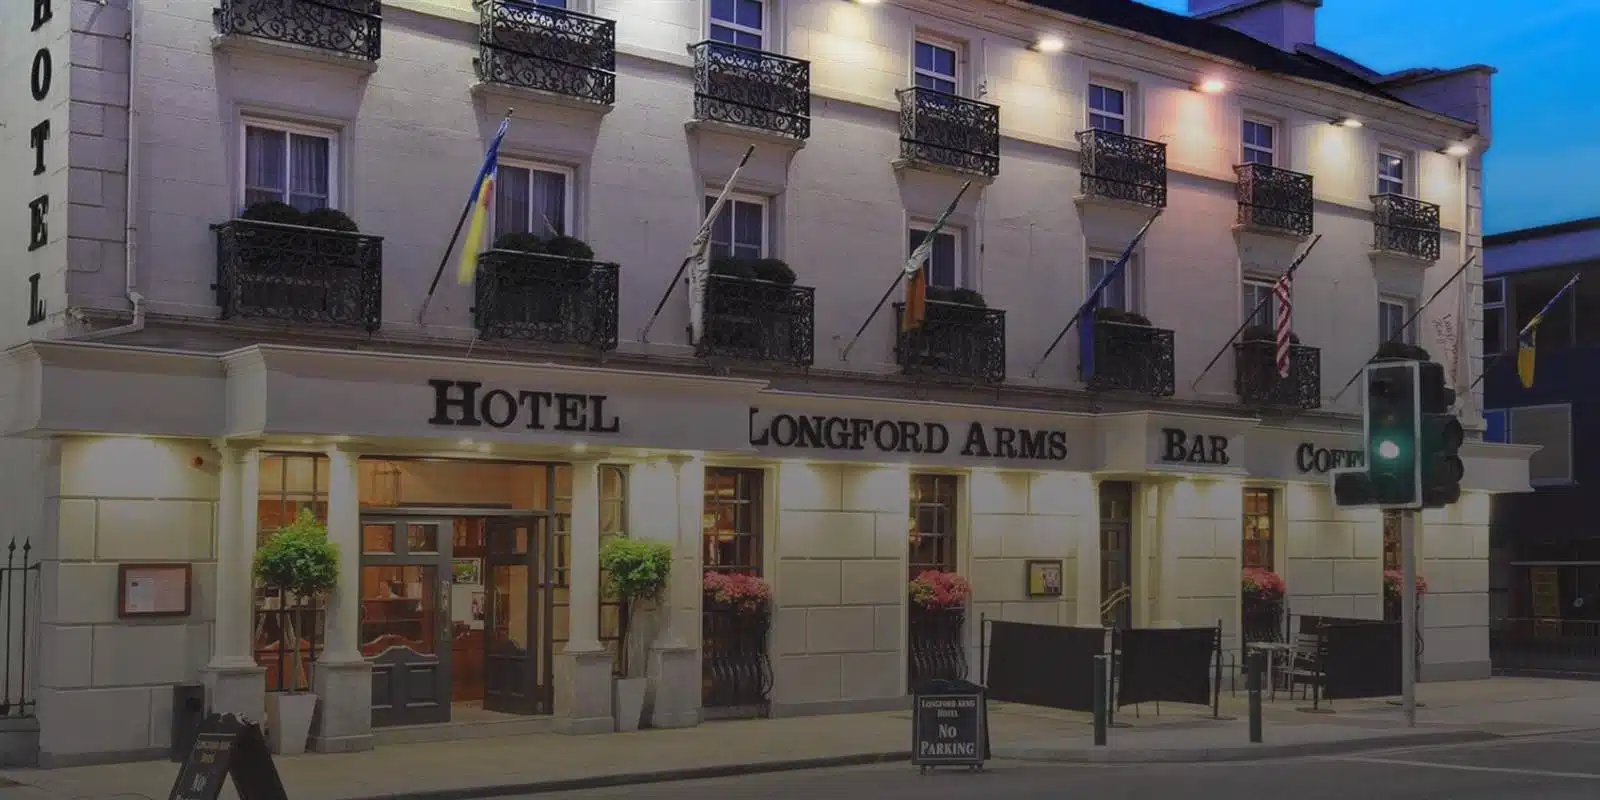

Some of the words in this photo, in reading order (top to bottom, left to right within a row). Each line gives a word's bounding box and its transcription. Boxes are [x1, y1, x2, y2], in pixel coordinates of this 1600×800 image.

[428, 379, 619, 433] HOTEL
[749, 407, 949, 453] LONGFORD
[960, 421, 1067, 460] ARMS
[1162, 428, 1230, 465] BAR
[1296, 442, 1365, 473] COFF
[920, 740, 975, 756] PARKING
